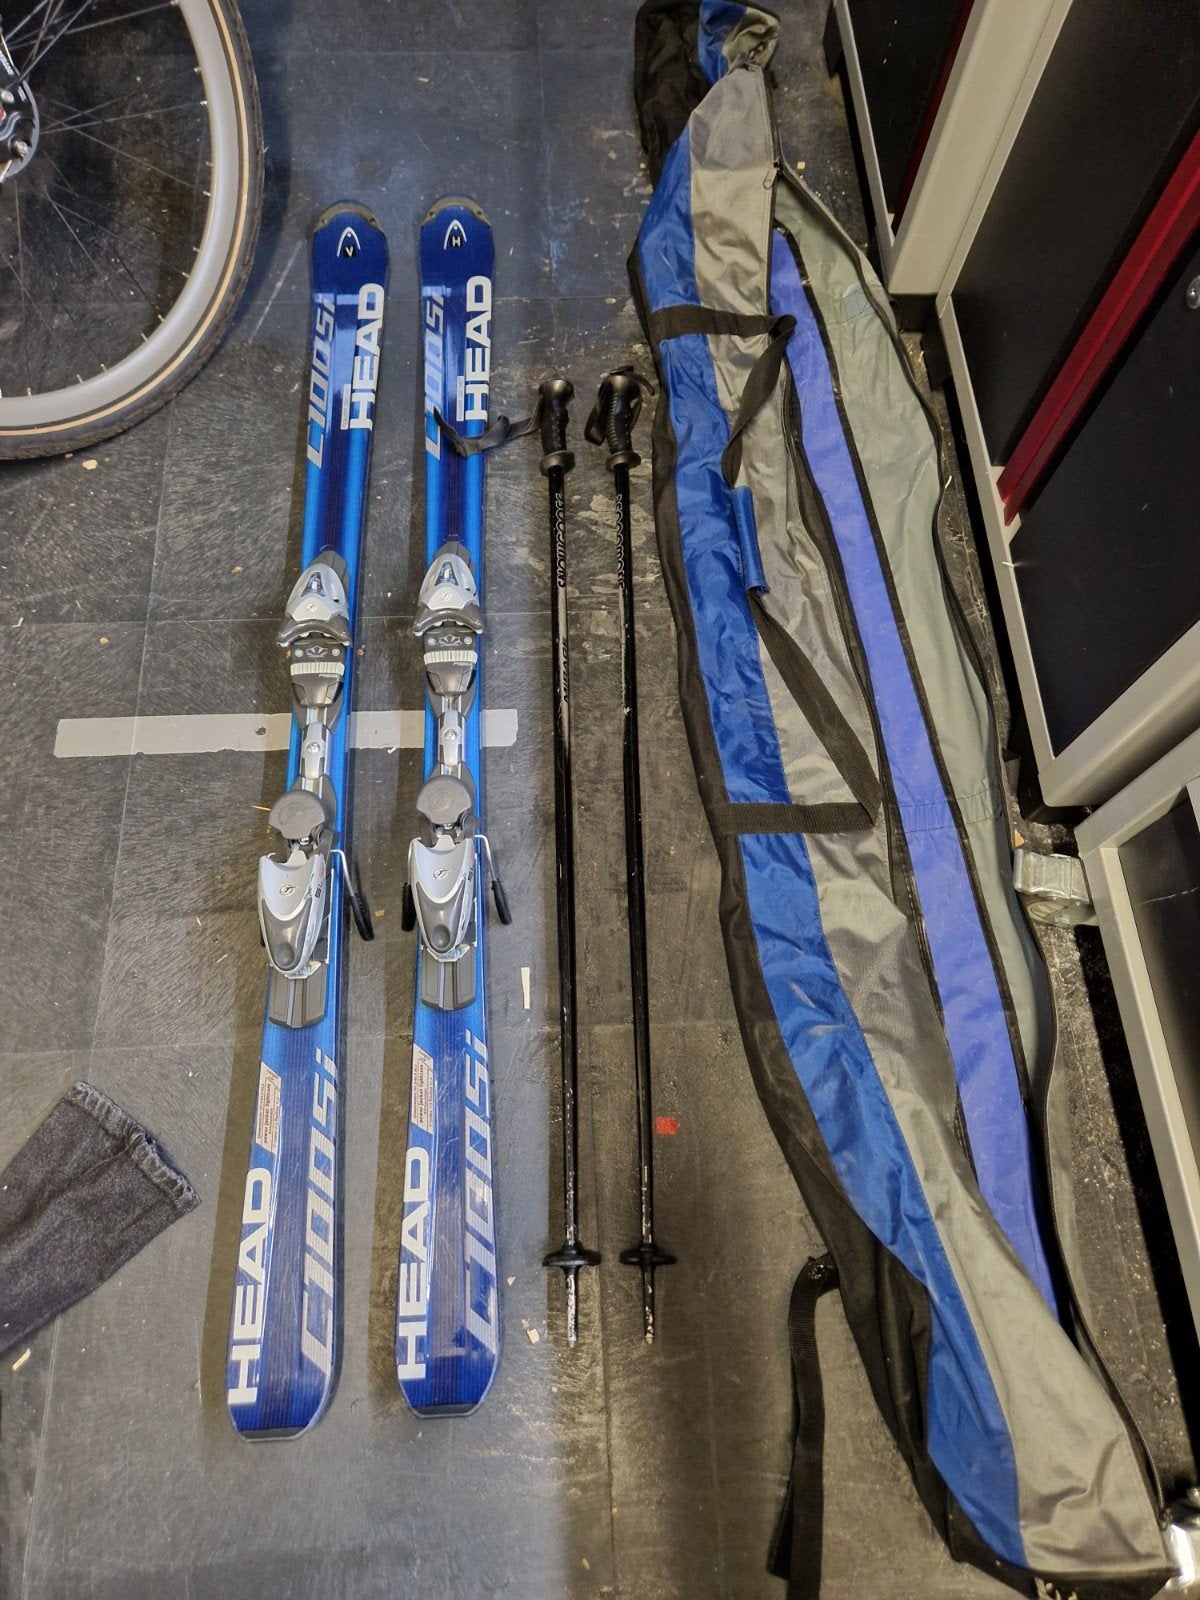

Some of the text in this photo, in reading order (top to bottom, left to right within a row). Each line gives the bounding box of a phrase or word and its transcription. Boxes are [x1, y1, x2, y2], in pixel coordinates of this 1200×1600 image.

[345, 245, 354, 257] V
[452, 235, 461, 247] H
[350, 283, 385, 431] HEAD
[465, 275, 492, 424] HEAD
[228, 1167, 272, 1405] HEAD
[399, 1146, 430, 1380] HEAD
